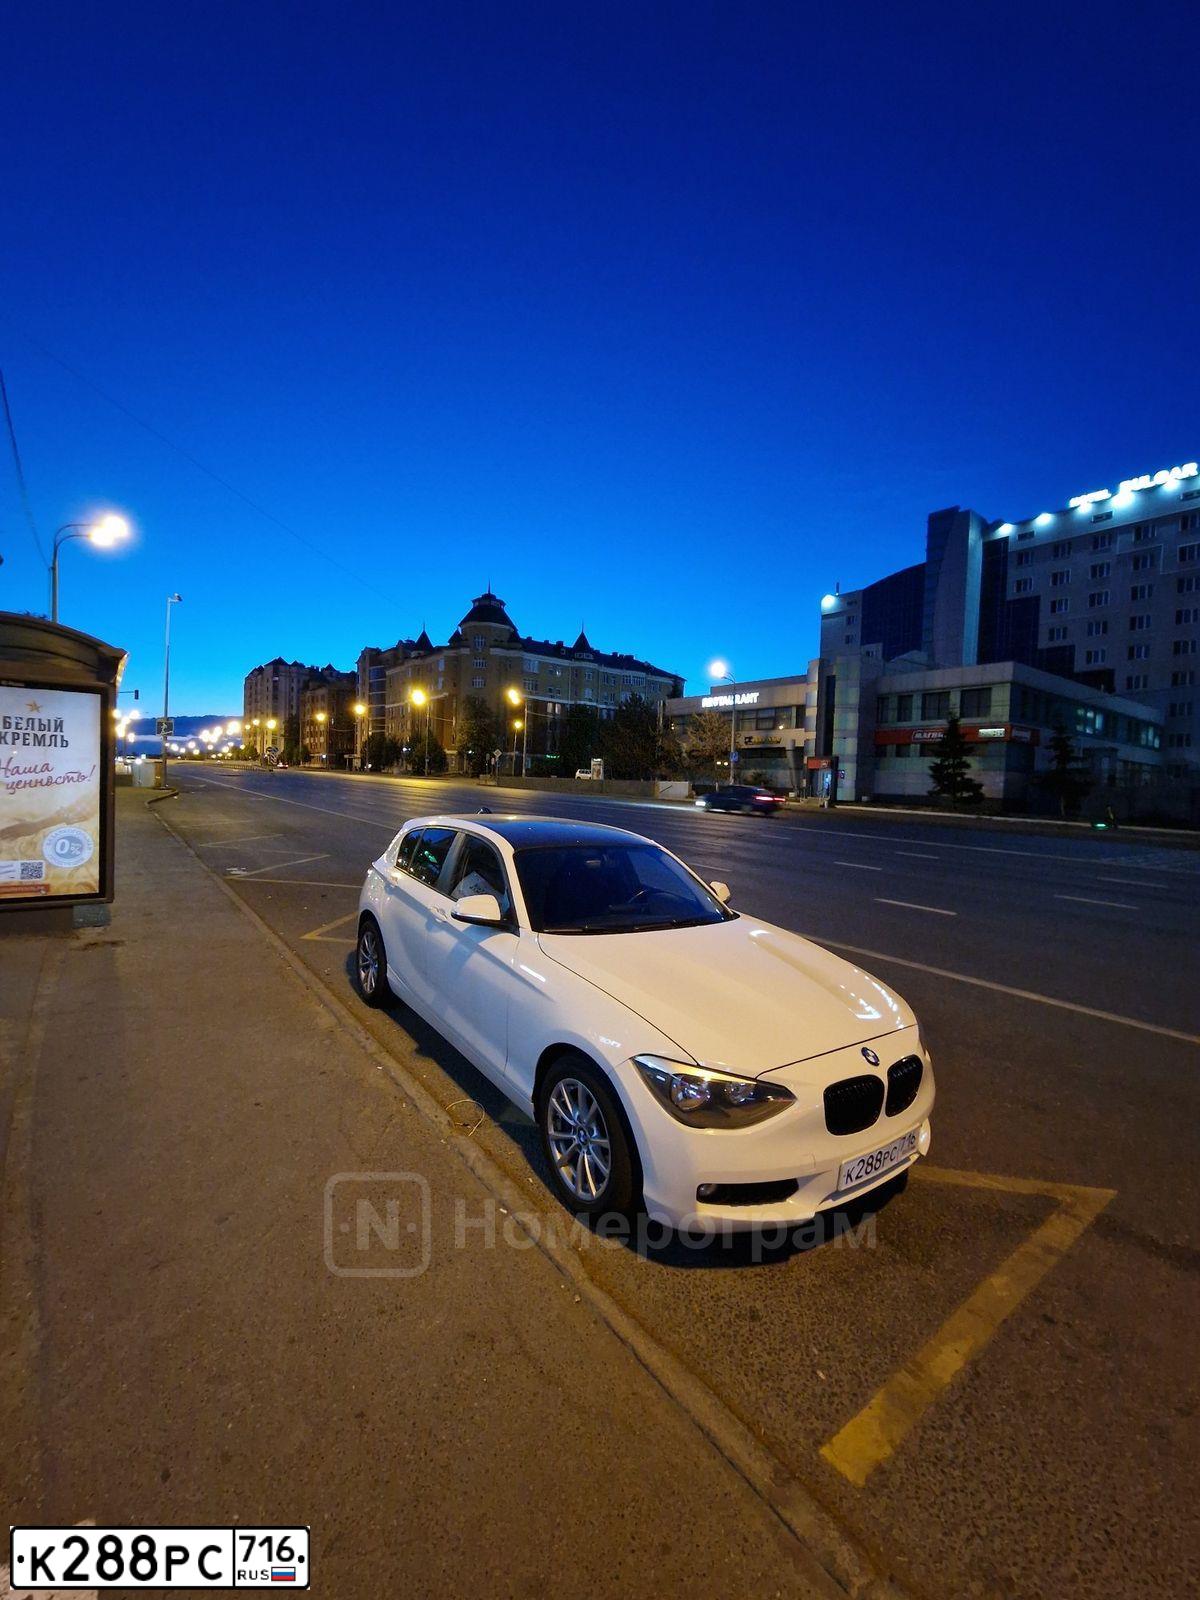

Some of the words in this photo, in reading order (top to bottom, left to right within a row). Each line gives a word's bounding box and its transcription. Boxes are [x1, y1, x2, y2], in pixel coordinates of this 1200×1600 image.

[2, 715, 65, 733] БЕЛЫЙ
[0, 730, 70, 748] КРЕМЛЬ
[0, 756, 55, 778] Наша
[6, 764, 97, 795] ценность!
[845, 1146, 898, 1185] К288РС
